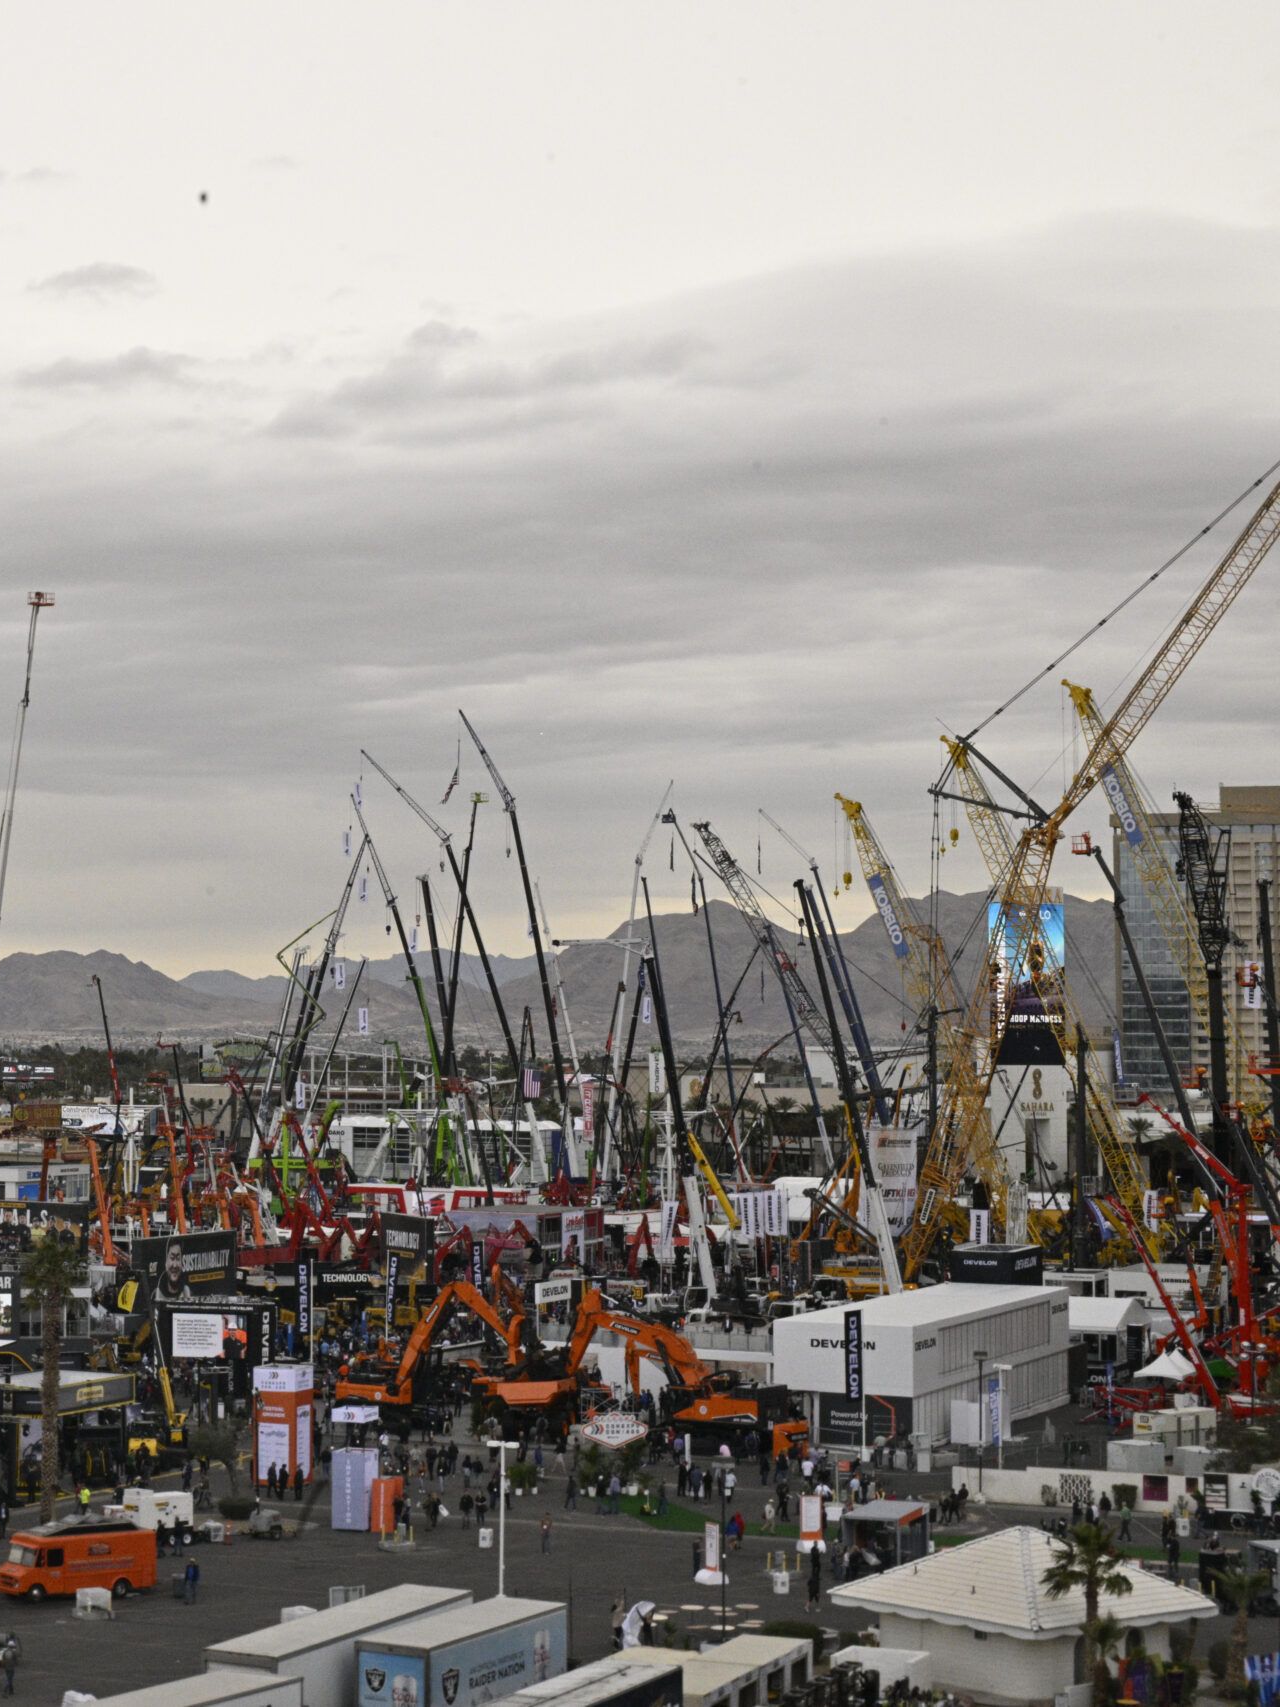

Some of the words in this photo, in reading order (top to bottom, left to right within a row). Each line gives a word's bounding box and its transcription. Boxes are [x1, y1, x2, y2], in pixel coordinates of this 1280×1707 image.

[1103, 773, 1136, 833] KOBELCO
[873, 885, 903, 945] KOBELCO
[1020, 1102, 1055, 1112] SAHARA
[386, 1229, 421, 1250] TECHNOLOGY
[181, 1248, 230, 1273] SUSTAINABILITY
[963, 1258, 998, 1266] DEVELON
[1015, 1255, 1038, 1271] DEVELON
[322, 1273, 371, 1283] TECHNOLOGY
[386, 1256, 397, 1322] DEVELON
[542, 1285, 569, 1298] DEVELON
[298, 1264, 308, 1333] DEVELON
[1052, 1302, 1068, 1316] DEVELON
[262, 1312, 270, 1366] DEVEL
[810, 1338, 876, 1351] DEVEN
[914, 1337, 937, 1352] DEVELON
[848, 1316, 859, 1398] DEVELON
[830, 1410, 859, 1420] Powered
[469, 1671, 497, 1689] RAIDER
[498, 1662, 526, 1679] NATION
